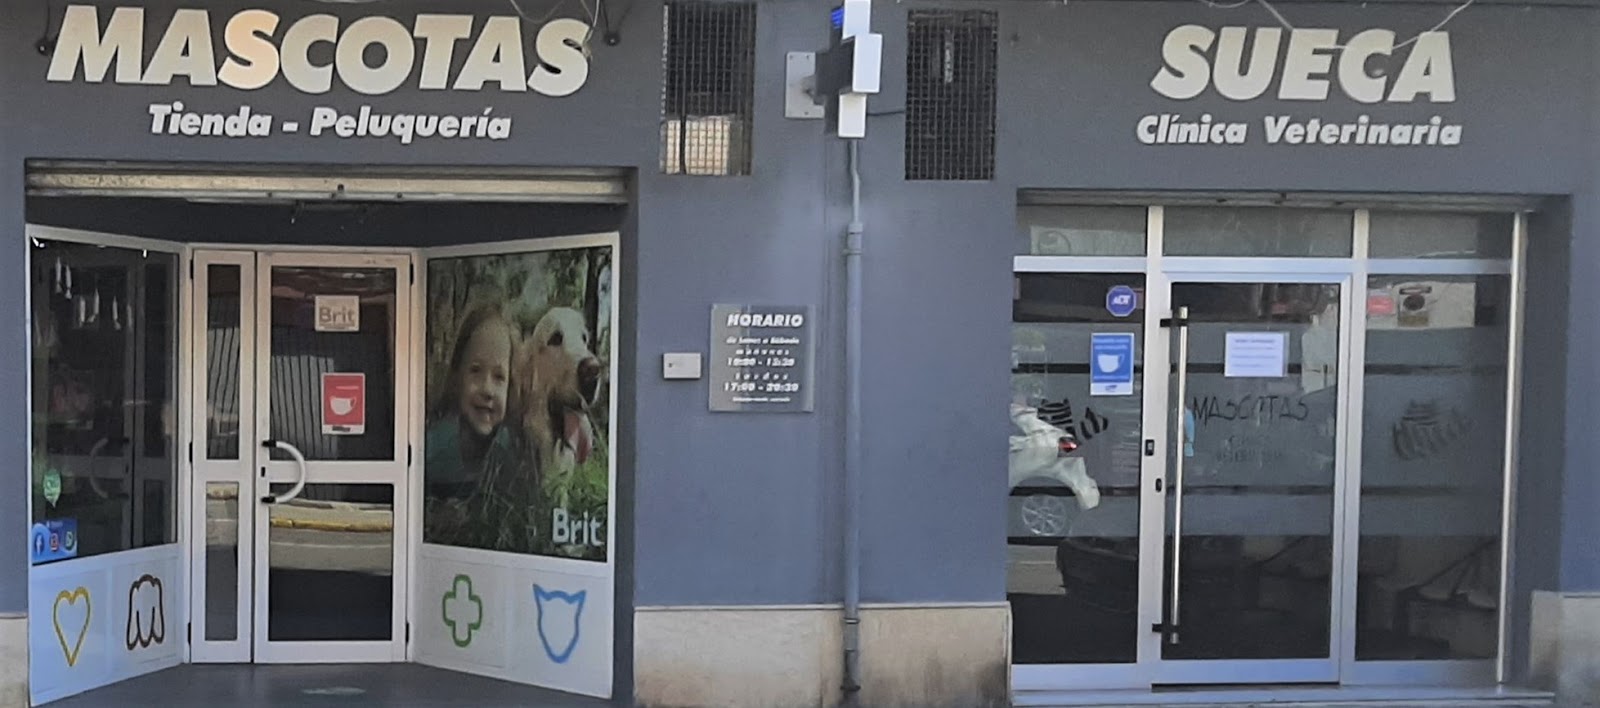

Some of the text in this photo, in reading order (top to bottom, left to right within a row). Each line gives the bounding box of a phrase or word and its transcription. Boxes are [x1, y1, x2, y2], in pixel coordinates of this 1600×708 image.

[47, 4, 591, 96] MASCOTAS
[1150, 24, 1456, 102] SUECA
[149, 102, 272, 137] Tienda
[310, 106, 512, 144] Peluquería
[1136, 113, 1463, 145] Clínica Veterinaria
[319, 306, 355, 324] Brit
[727, 313, 803, 327] HORARIO
[724, 382, 756, 392] 17:00
[552, 507, 605, 546] Brit
